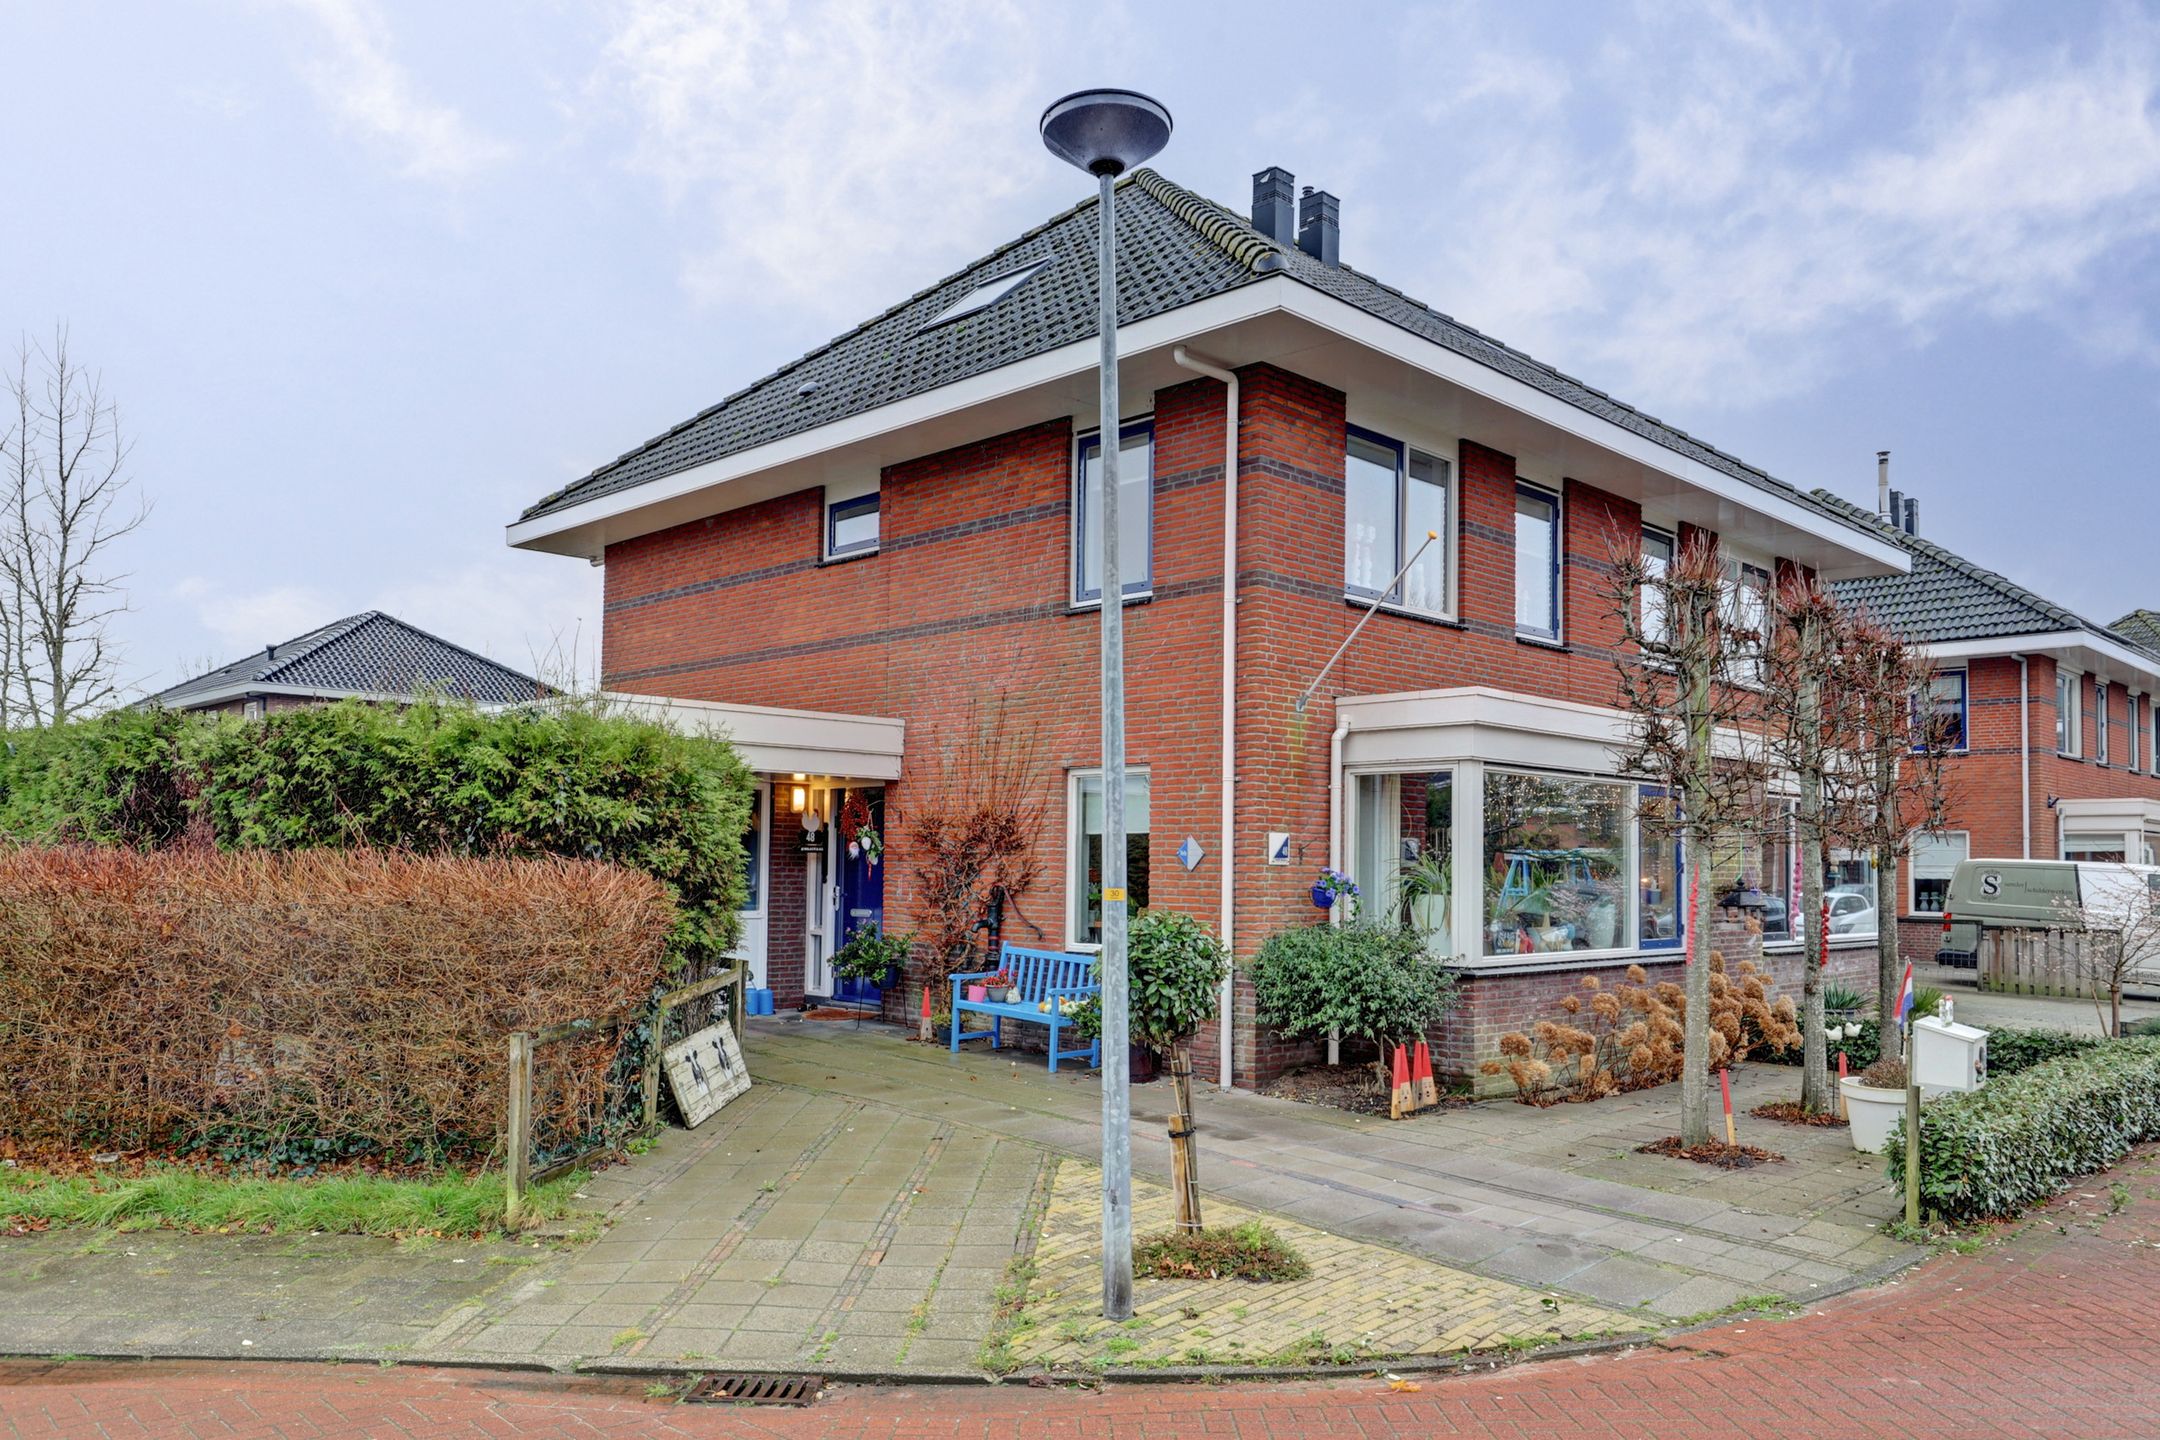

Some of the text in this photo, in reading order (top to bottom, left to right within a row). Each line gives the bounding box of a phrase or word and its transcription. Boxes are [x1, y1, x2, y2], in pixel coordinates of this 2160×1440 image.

[806, 831, 815, 842] 48
[1983, 875, 1998, 895] S
[1110, 889, 1120, 897] 30
